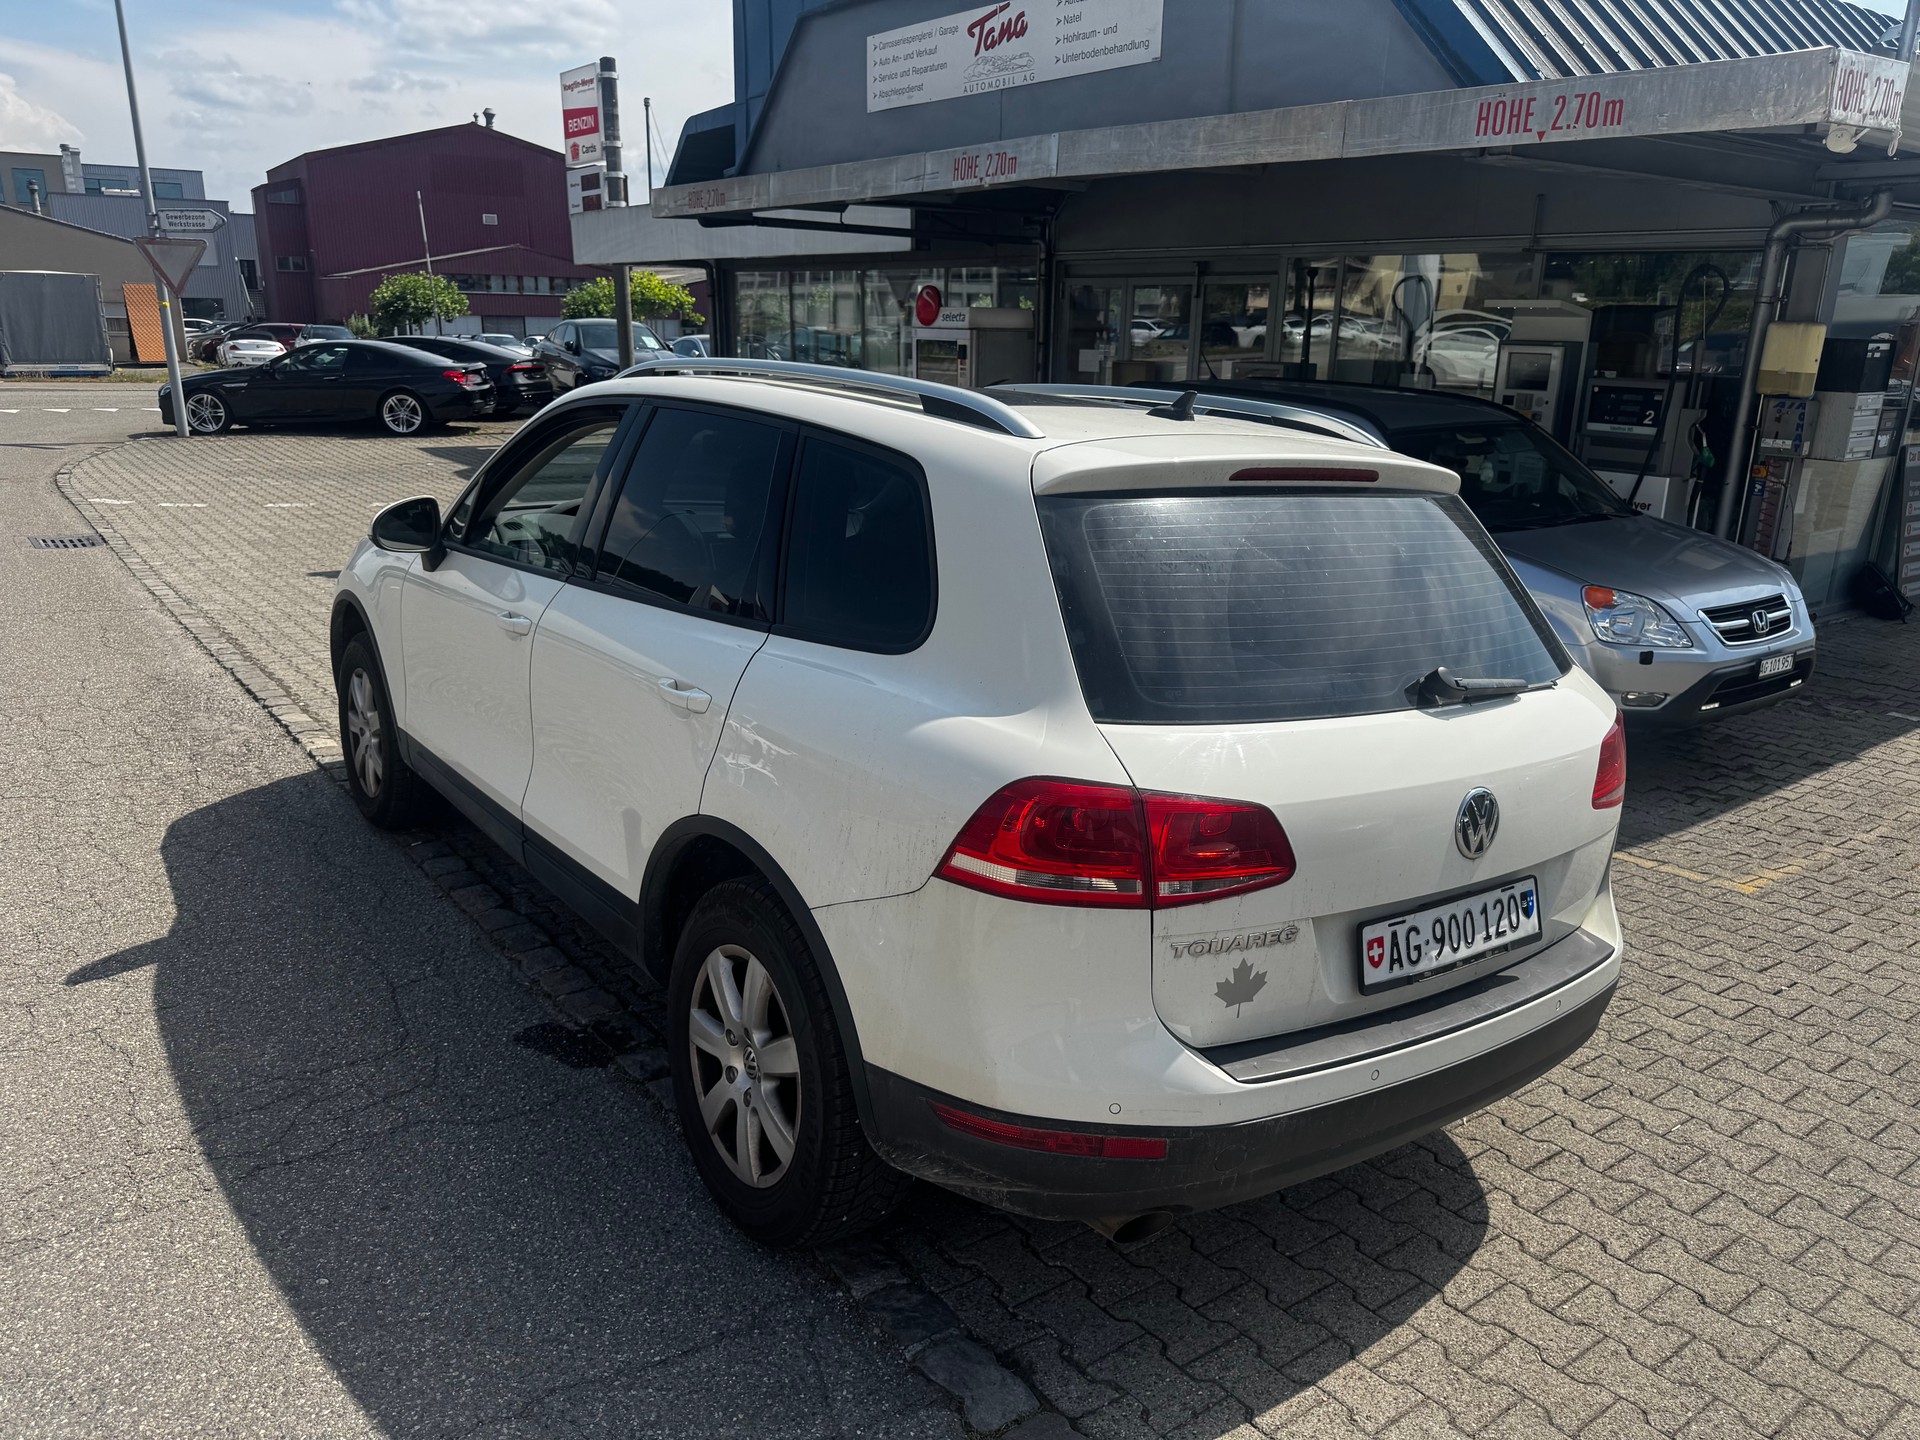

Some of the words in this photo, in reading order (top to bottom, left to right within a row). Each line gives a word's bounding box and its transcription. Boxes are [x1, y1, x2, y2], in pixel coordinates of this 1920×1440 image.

[1063, 11, 1082, 25] Natel
[938, 24, 959, 36] Garage
[967, 1, 1029, 58] Tana
[1103, 23, 1118, 36] und
[878, 57, 891, 67] Auto
[903, 50, 915, 61] und
[915, 44, 938, 58] Verkauf
[1062, 39, 1150, 64] Unterbodenbehandlung
[878, 71, 898, 83] Service
[899, 68, 911, 78] und
[911, 62, 948, 76] Reparaturen
[962, 76, 1016, 94] AUTOMOBIL
[1022, 72, 1036, 83] AG
[878, 83, 924, 99] Abschleppdienst
[1834, 60, 1869, 115] HÖHE
[568, 114, 595, 133] BENZIN
[1475, 92, 1537, 137] HÖHE
[581, 144, 597, 155] Cards
[952, 152, 980, 182] HÖHE
[941, 312, 966, 323] selecta
[1643, 409, 1655, 425] 2
[1170, 925, 1300, 959] TOUAREG
